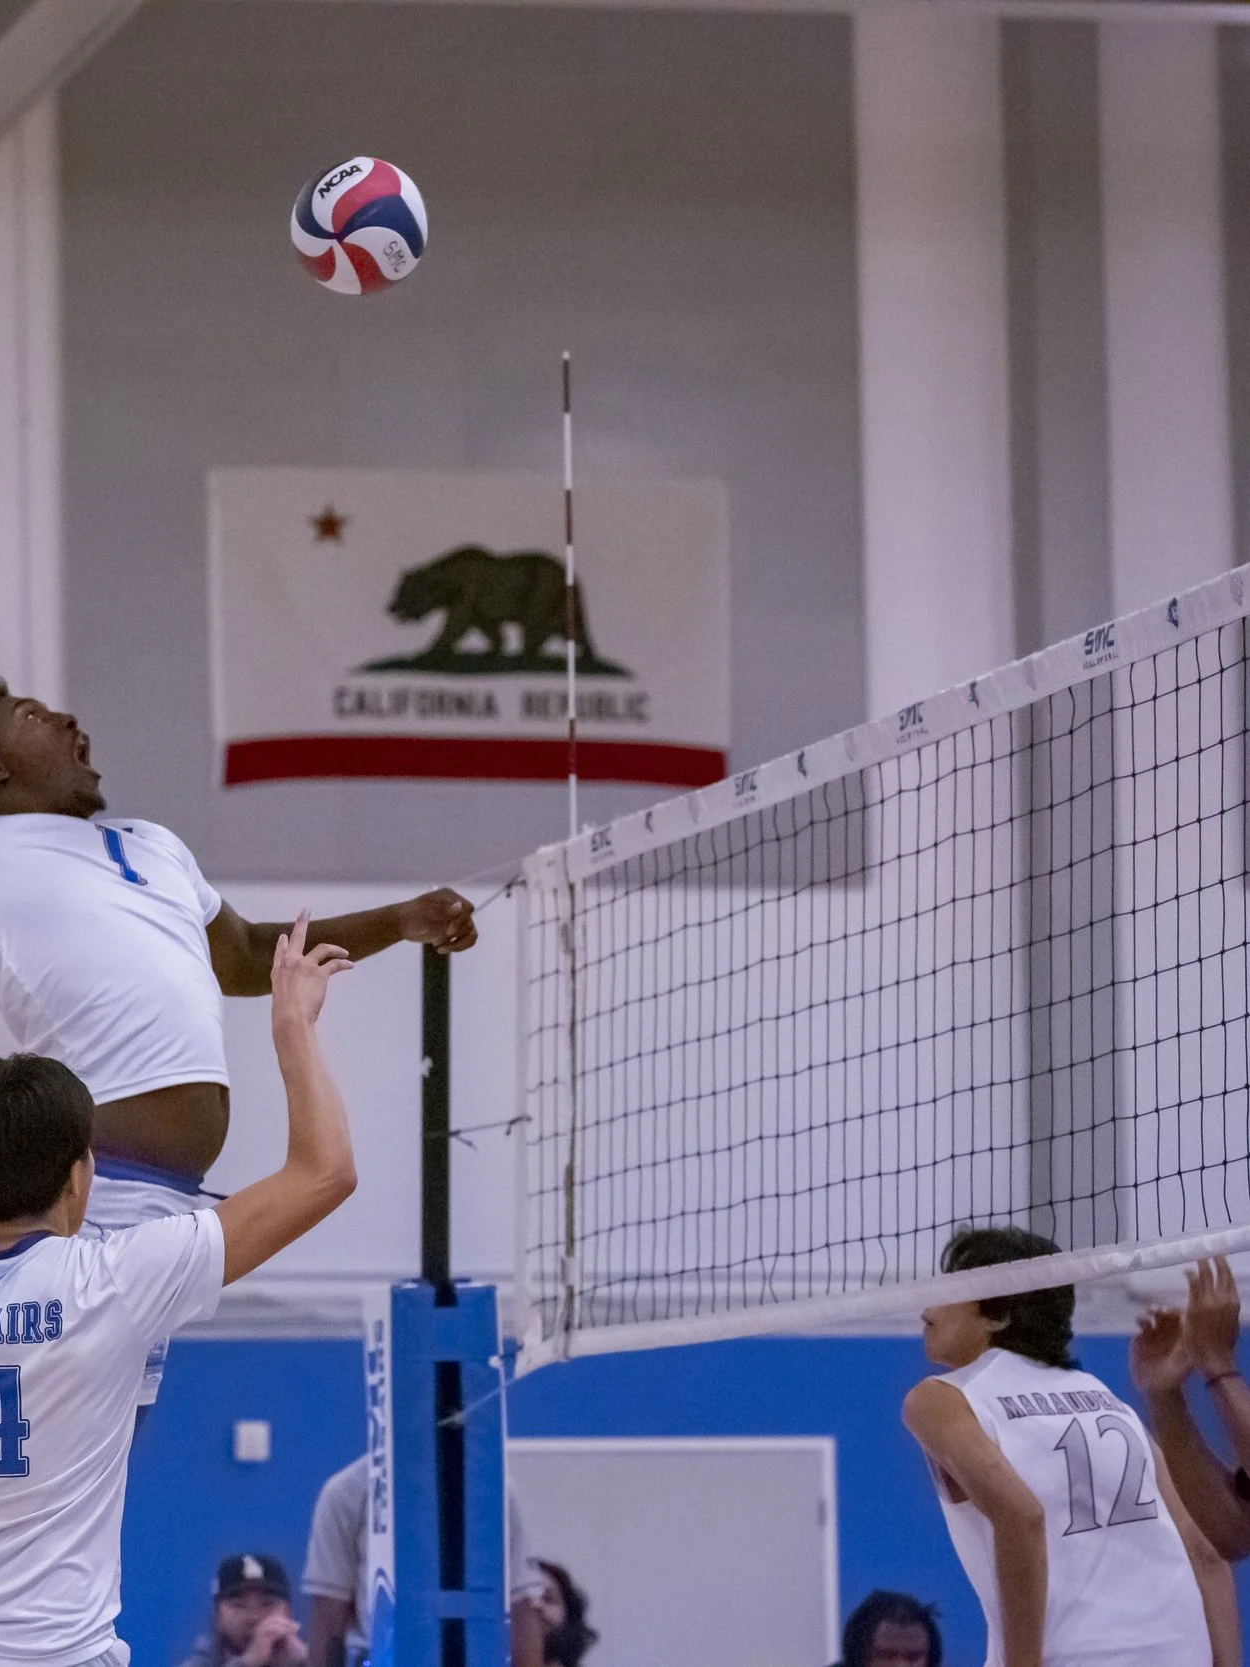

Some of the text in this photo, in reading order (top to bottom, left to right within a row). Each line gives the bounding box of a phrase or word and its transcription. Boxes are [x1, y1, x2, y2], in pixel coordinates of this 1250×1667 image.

[317, 164, 362, 200] NCAA
[383, 240, 407, 273] SMC
[1084, 623, 1115, 656] SMC
[333, 685, 650, 723] CALIFORNIA REPUBLIC
[95, 824, 148, 886] 1
[1053, 1414, 1159, 1537] 12
